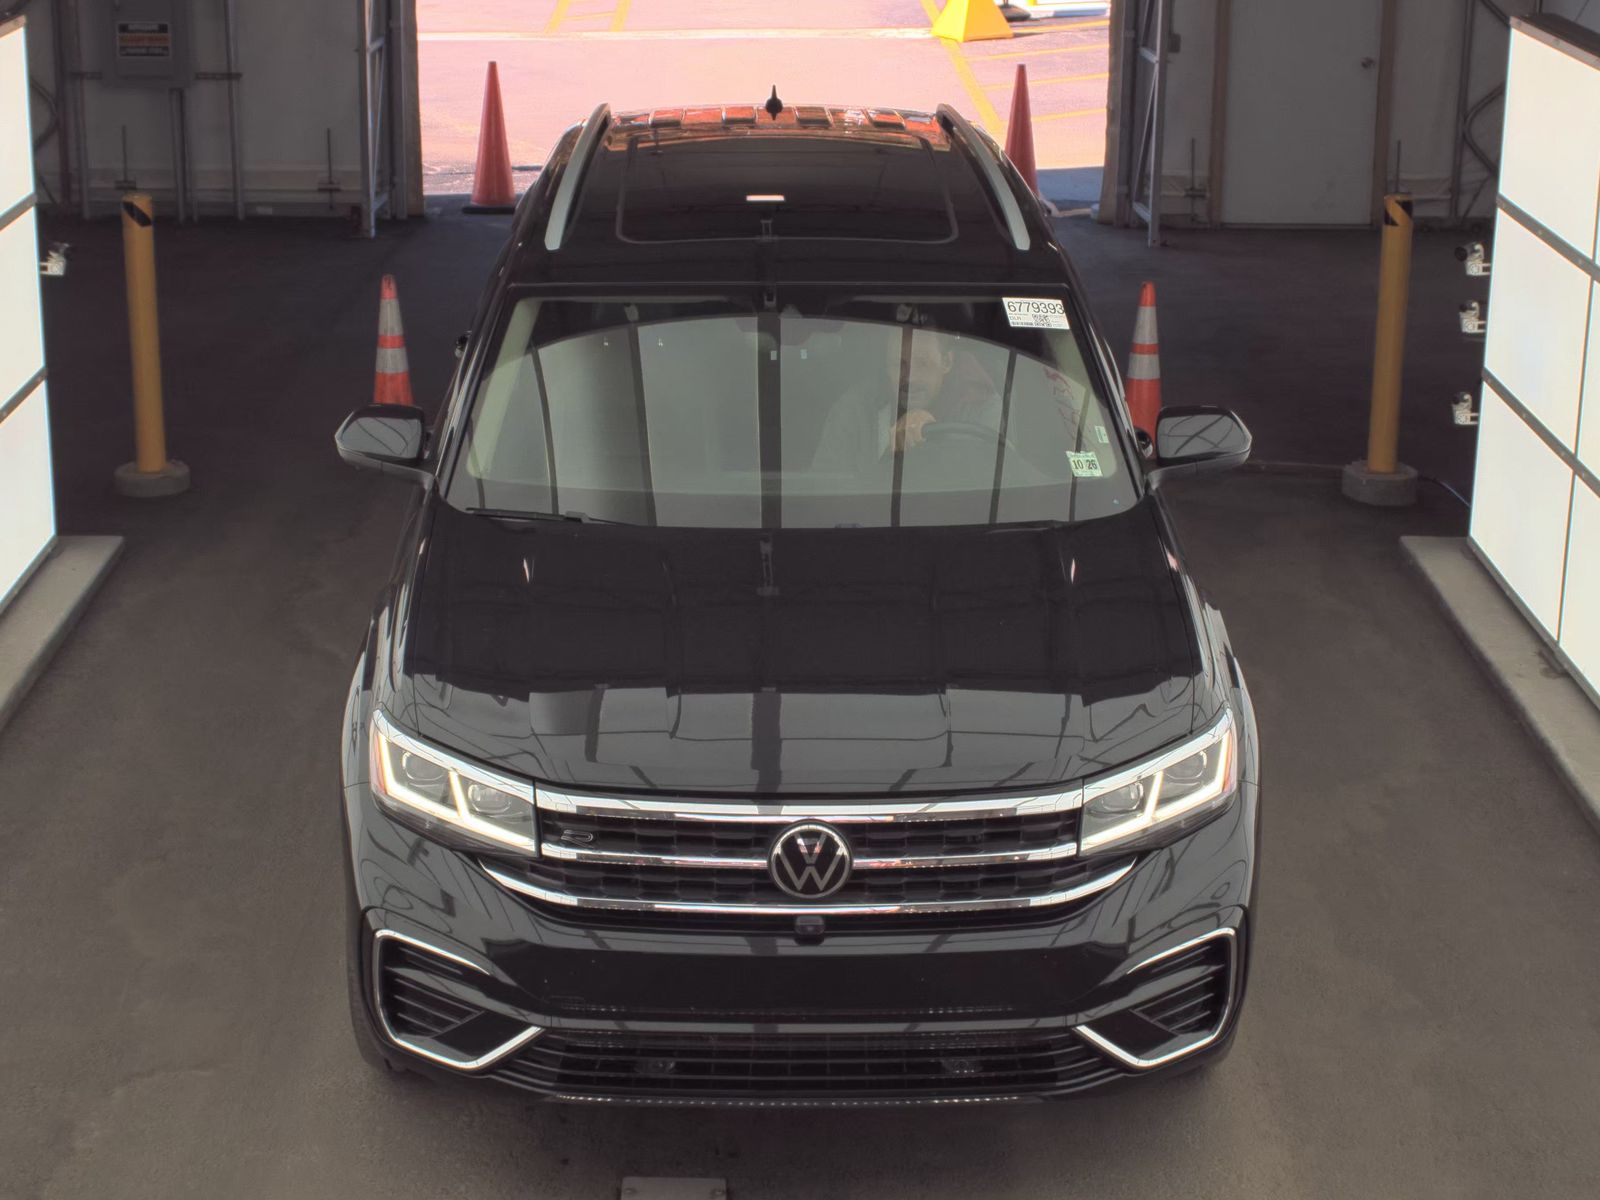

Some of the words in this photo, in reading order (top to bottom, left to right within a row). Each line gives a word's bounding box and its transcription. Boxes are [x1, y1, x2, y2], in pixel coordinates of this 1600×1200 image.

[1007, 301, 1065, 314] 6779393
[1072, 459, 1084, 470] 10
[1086, 459, 1098, 470] 26
[773, 828, 847, 895] VW
